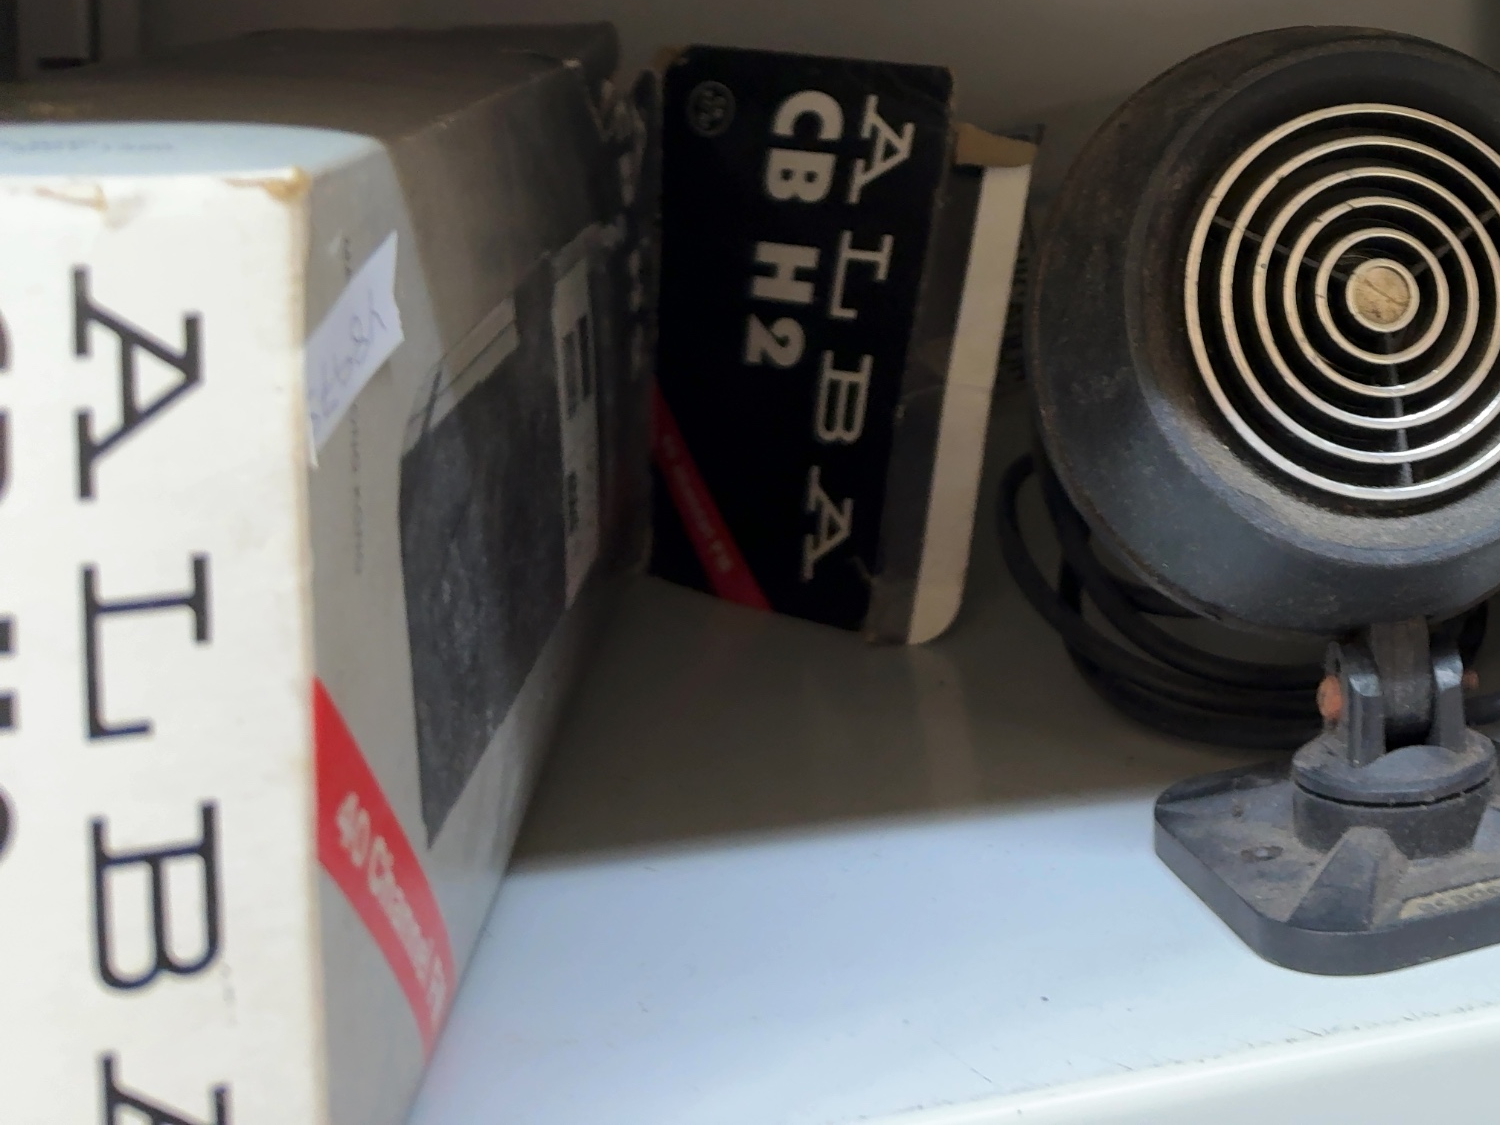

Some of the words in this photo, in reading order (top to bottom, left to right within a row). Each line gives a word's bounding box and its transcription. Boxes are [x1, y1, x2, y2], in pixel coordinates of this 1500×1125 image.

[763, 89, 844, 205] CB
[743, 240, 821, 367] H2
[801, 94, 915, 580] ALBA
